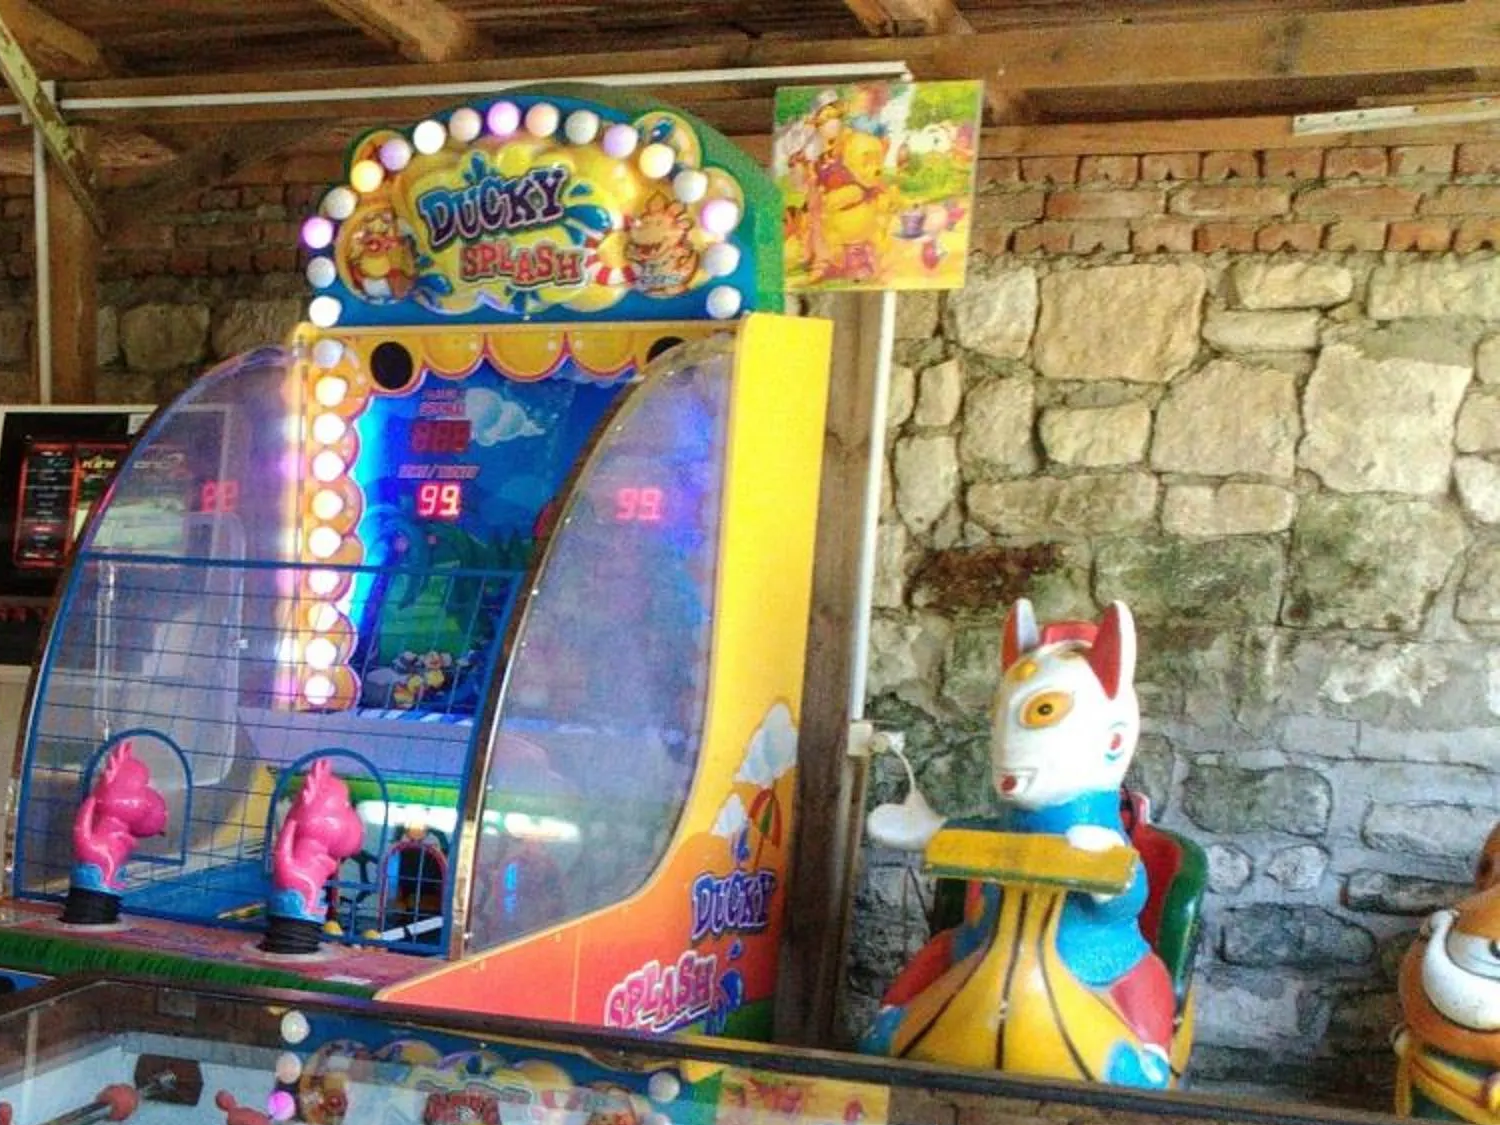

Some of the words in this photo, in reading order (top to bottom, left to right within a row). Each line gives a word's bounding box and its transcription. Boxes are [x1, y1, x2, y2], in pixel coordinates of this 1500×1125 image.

[418, 164, 570, 249] DUCKY
[459, 238, 586, 288] SPLASH
[418, 484, 461, 517] 99
[691, 869, 778, 942] DUCKY
[604, 950, 719, 1033] SPLASH
